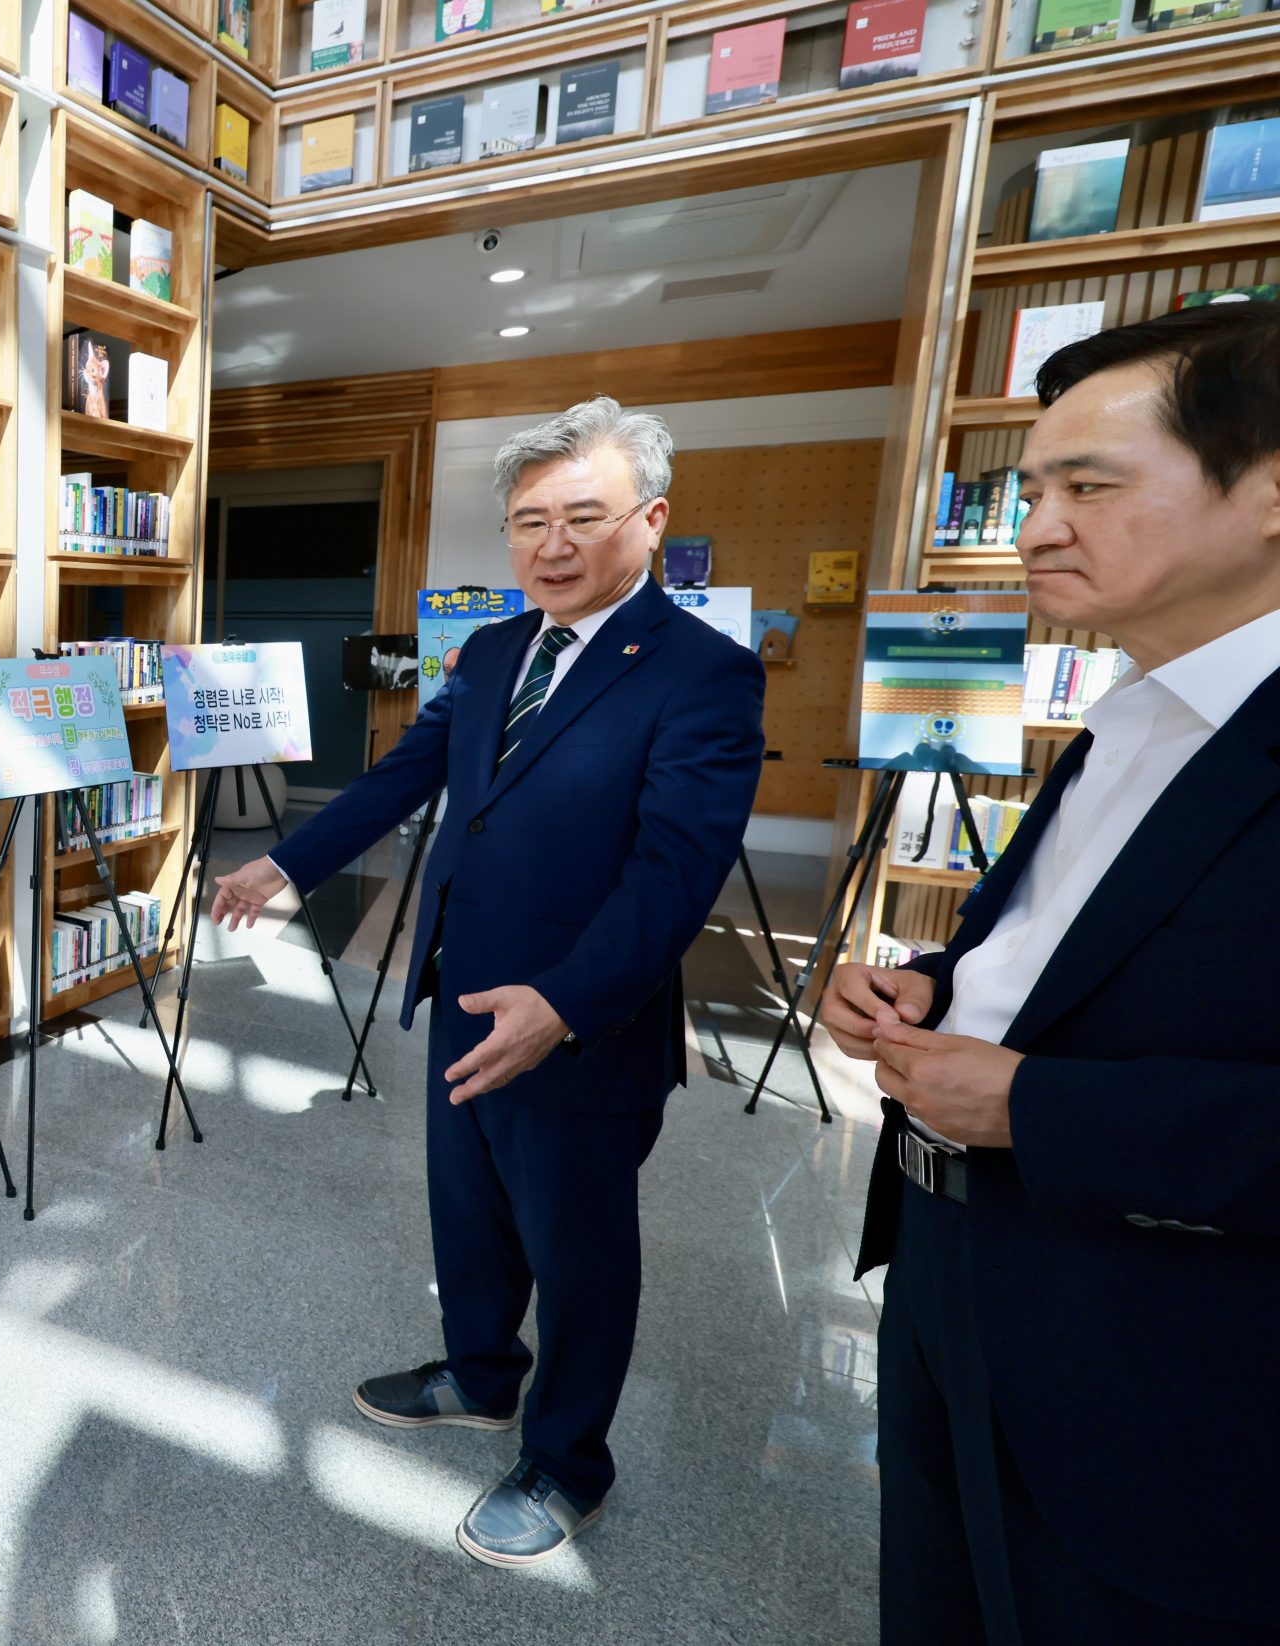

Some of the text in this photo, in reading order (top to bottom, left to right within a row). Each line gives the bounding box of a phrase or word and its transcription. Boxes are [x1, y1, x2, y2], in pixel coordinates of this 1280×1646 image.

[673, 594, 699, 606] 우수상
[39, 665, 60, 677] 우수상
[193, 687, 285, 709] 청렴은 나로 시작!
[194, 711, 292, 734] 청탁은 No로 시작!
[64, 727, 76, 744] 행
[70, 760, 80, 775] 정
